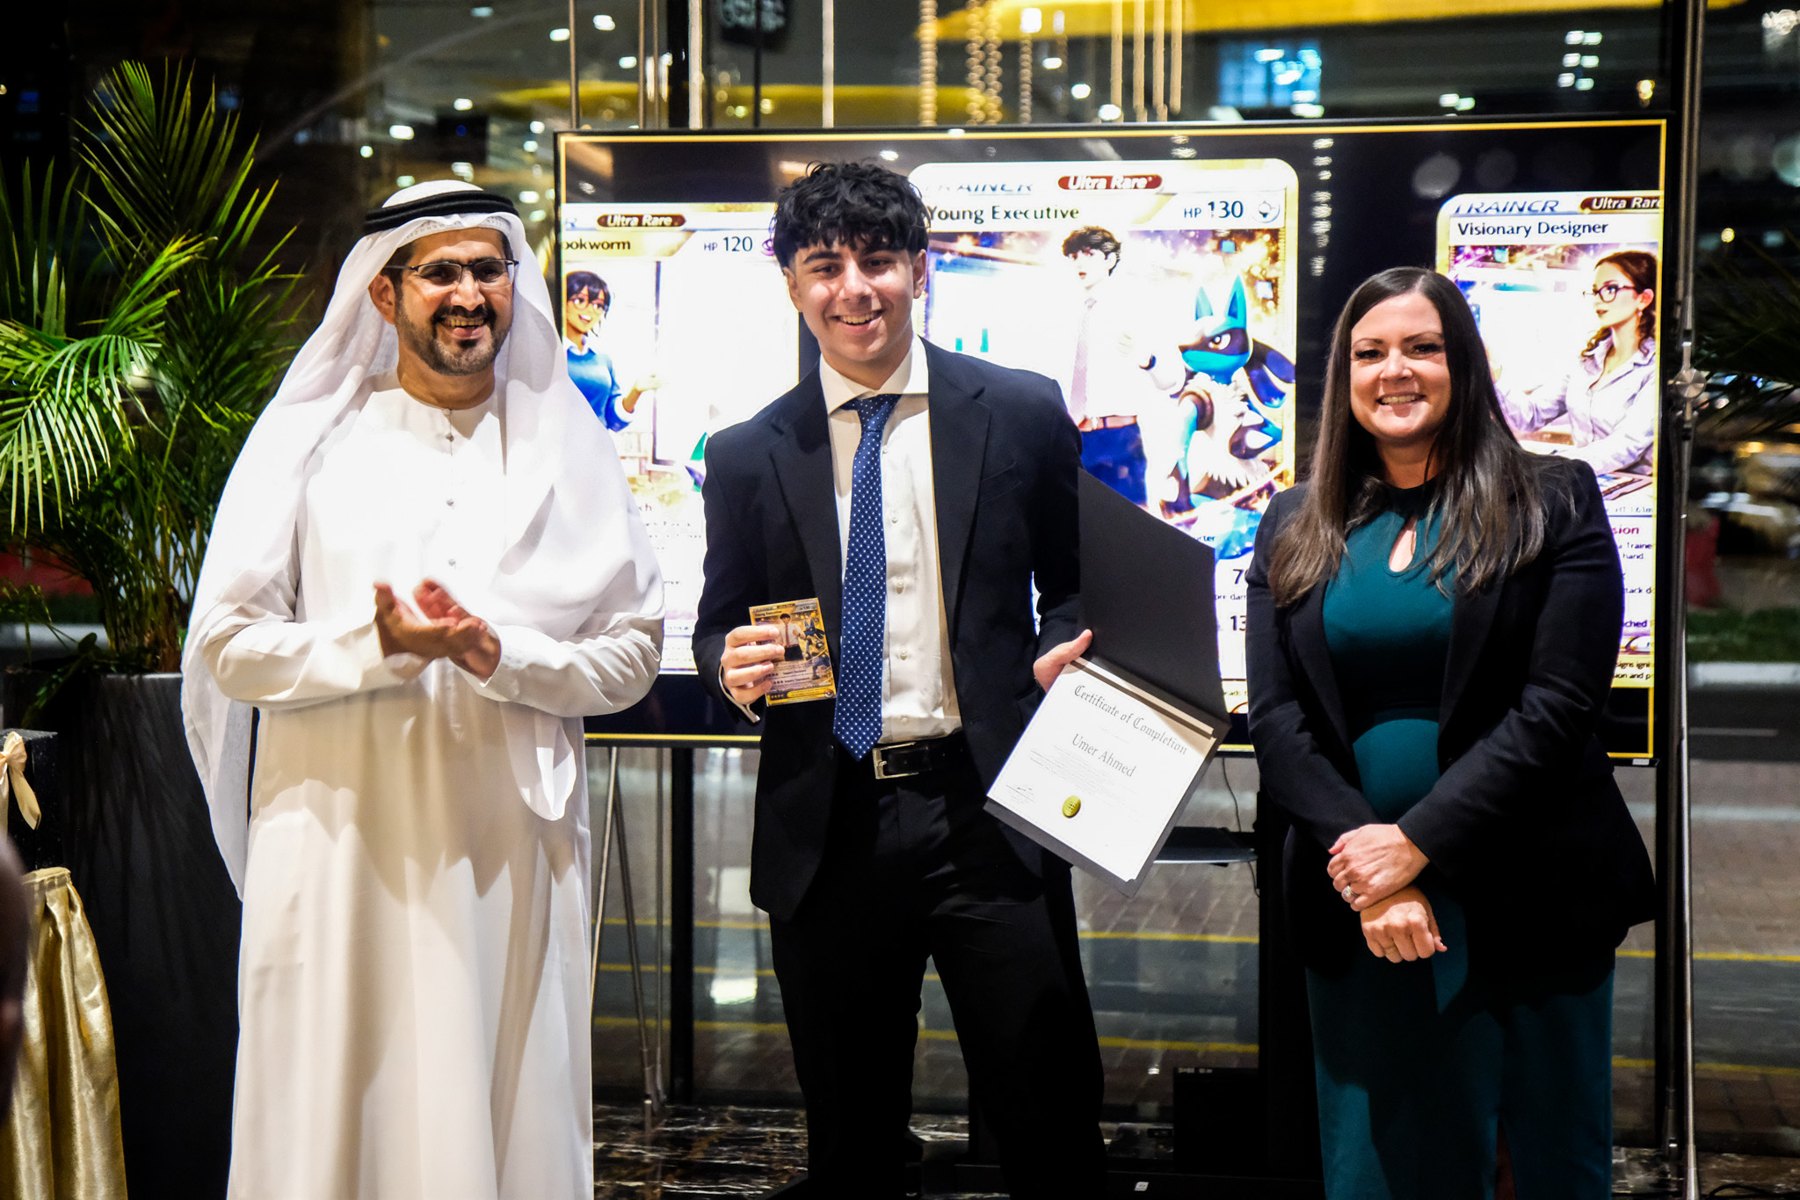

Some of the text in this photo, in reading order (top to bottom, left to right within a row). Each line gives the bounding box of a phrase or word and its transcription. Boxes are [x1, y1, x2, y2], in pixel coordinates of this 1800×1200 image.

[1068, 175, 1149, 190] Ultra Rare
[1184, 200, 1244, 218] HP 130
[1591, 197, 1627, 210] Ultra
[606, 213, 673, 227] Ultra Rare
[927, 205, 1079, 225] Young Executive
[1457, 220, 1609, 239] Visionary Designer
[703, 236, 753, 252] HP 120
[1232, 568, 1248, 585] 7
[1074, 684, 1120, 718] Certificate
[1120, 712, 1134, 725] of
[1132, 717, 1189, 756] Completion
[1072, 733, 1098, 757] Umer
[1098, 751, 1137, 778] Ahmed
